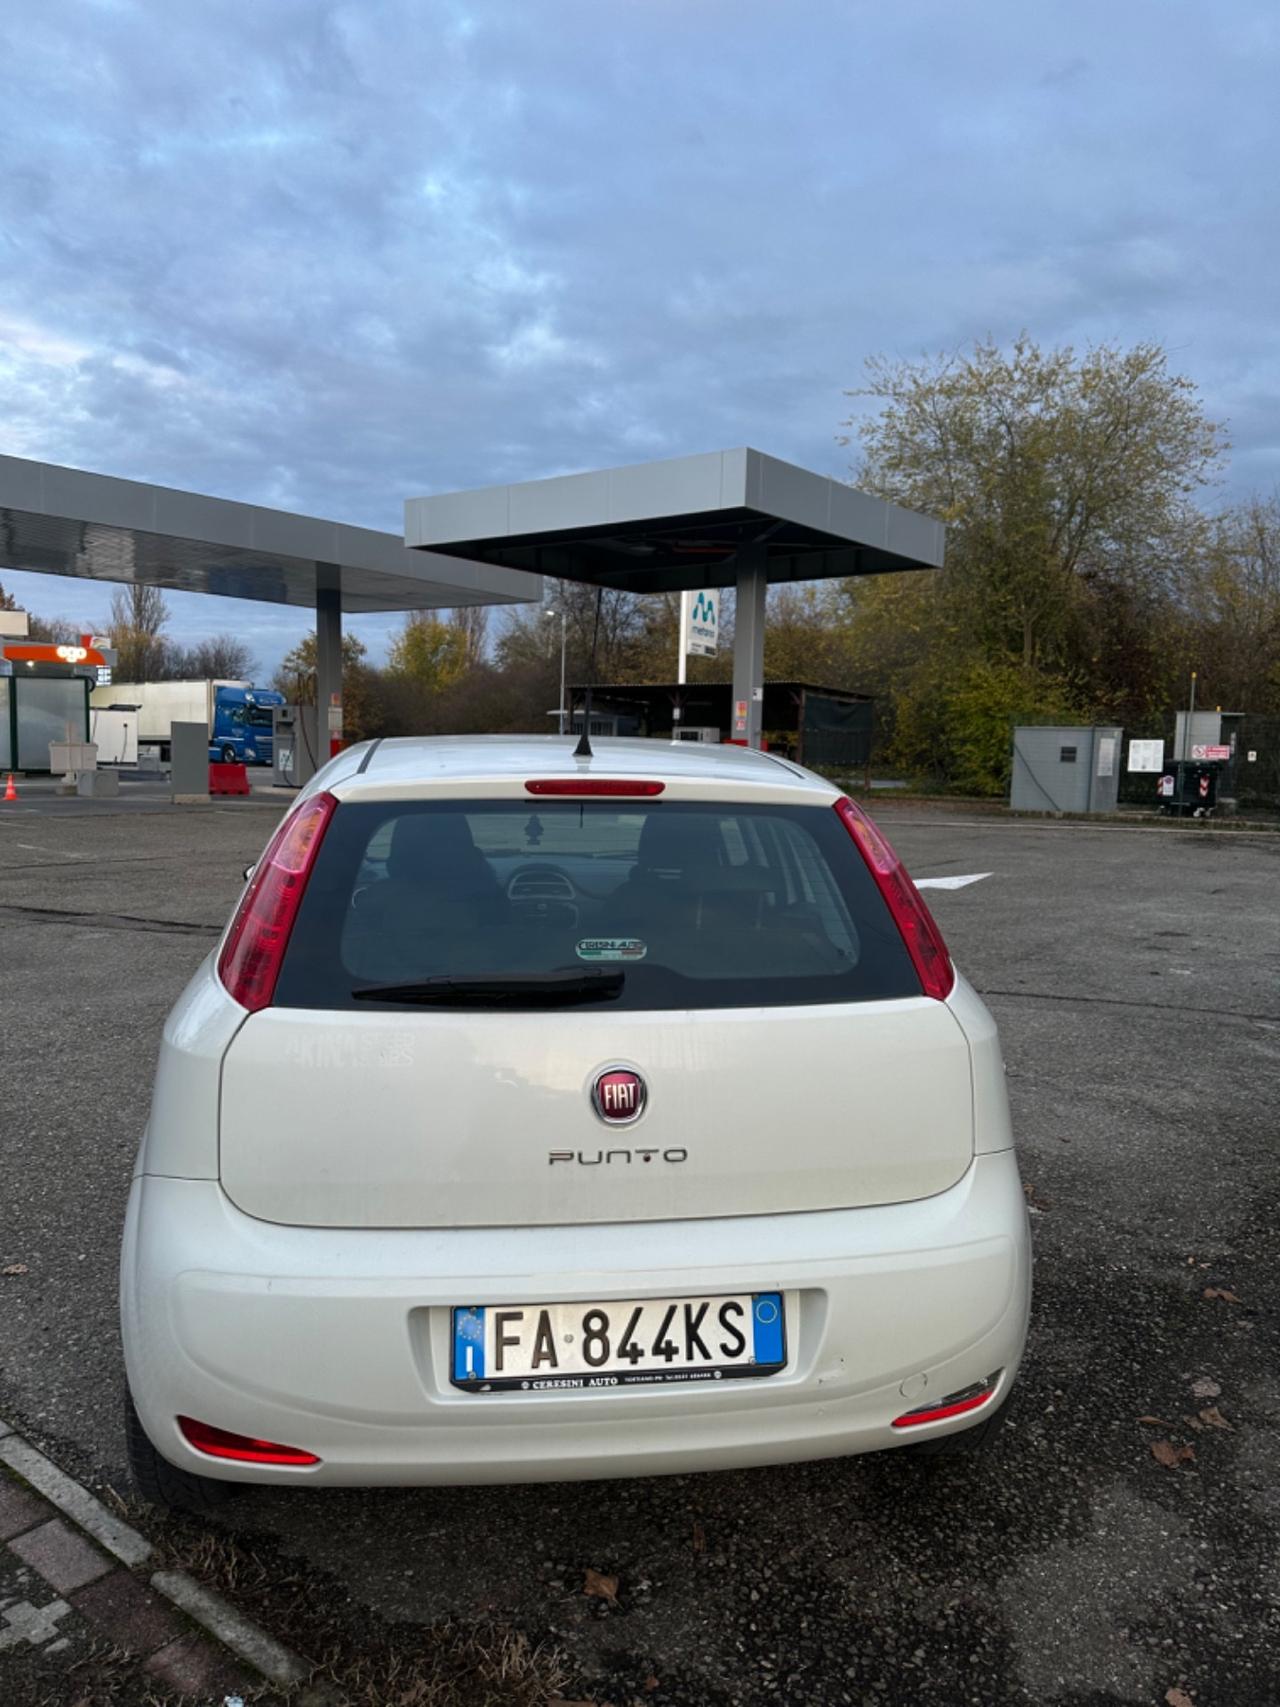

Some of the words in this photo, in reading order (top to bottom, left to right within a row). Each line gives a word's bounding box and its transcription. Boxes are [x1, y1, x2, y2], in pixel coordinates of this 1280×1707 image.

[604, 1083, 636, 1110] FIAT
[548, 1148, 688, 1166] PUNTO
[532, 1379, 584, 1390] CERESINI
[588, 1377, 618, 1388] AUTO
